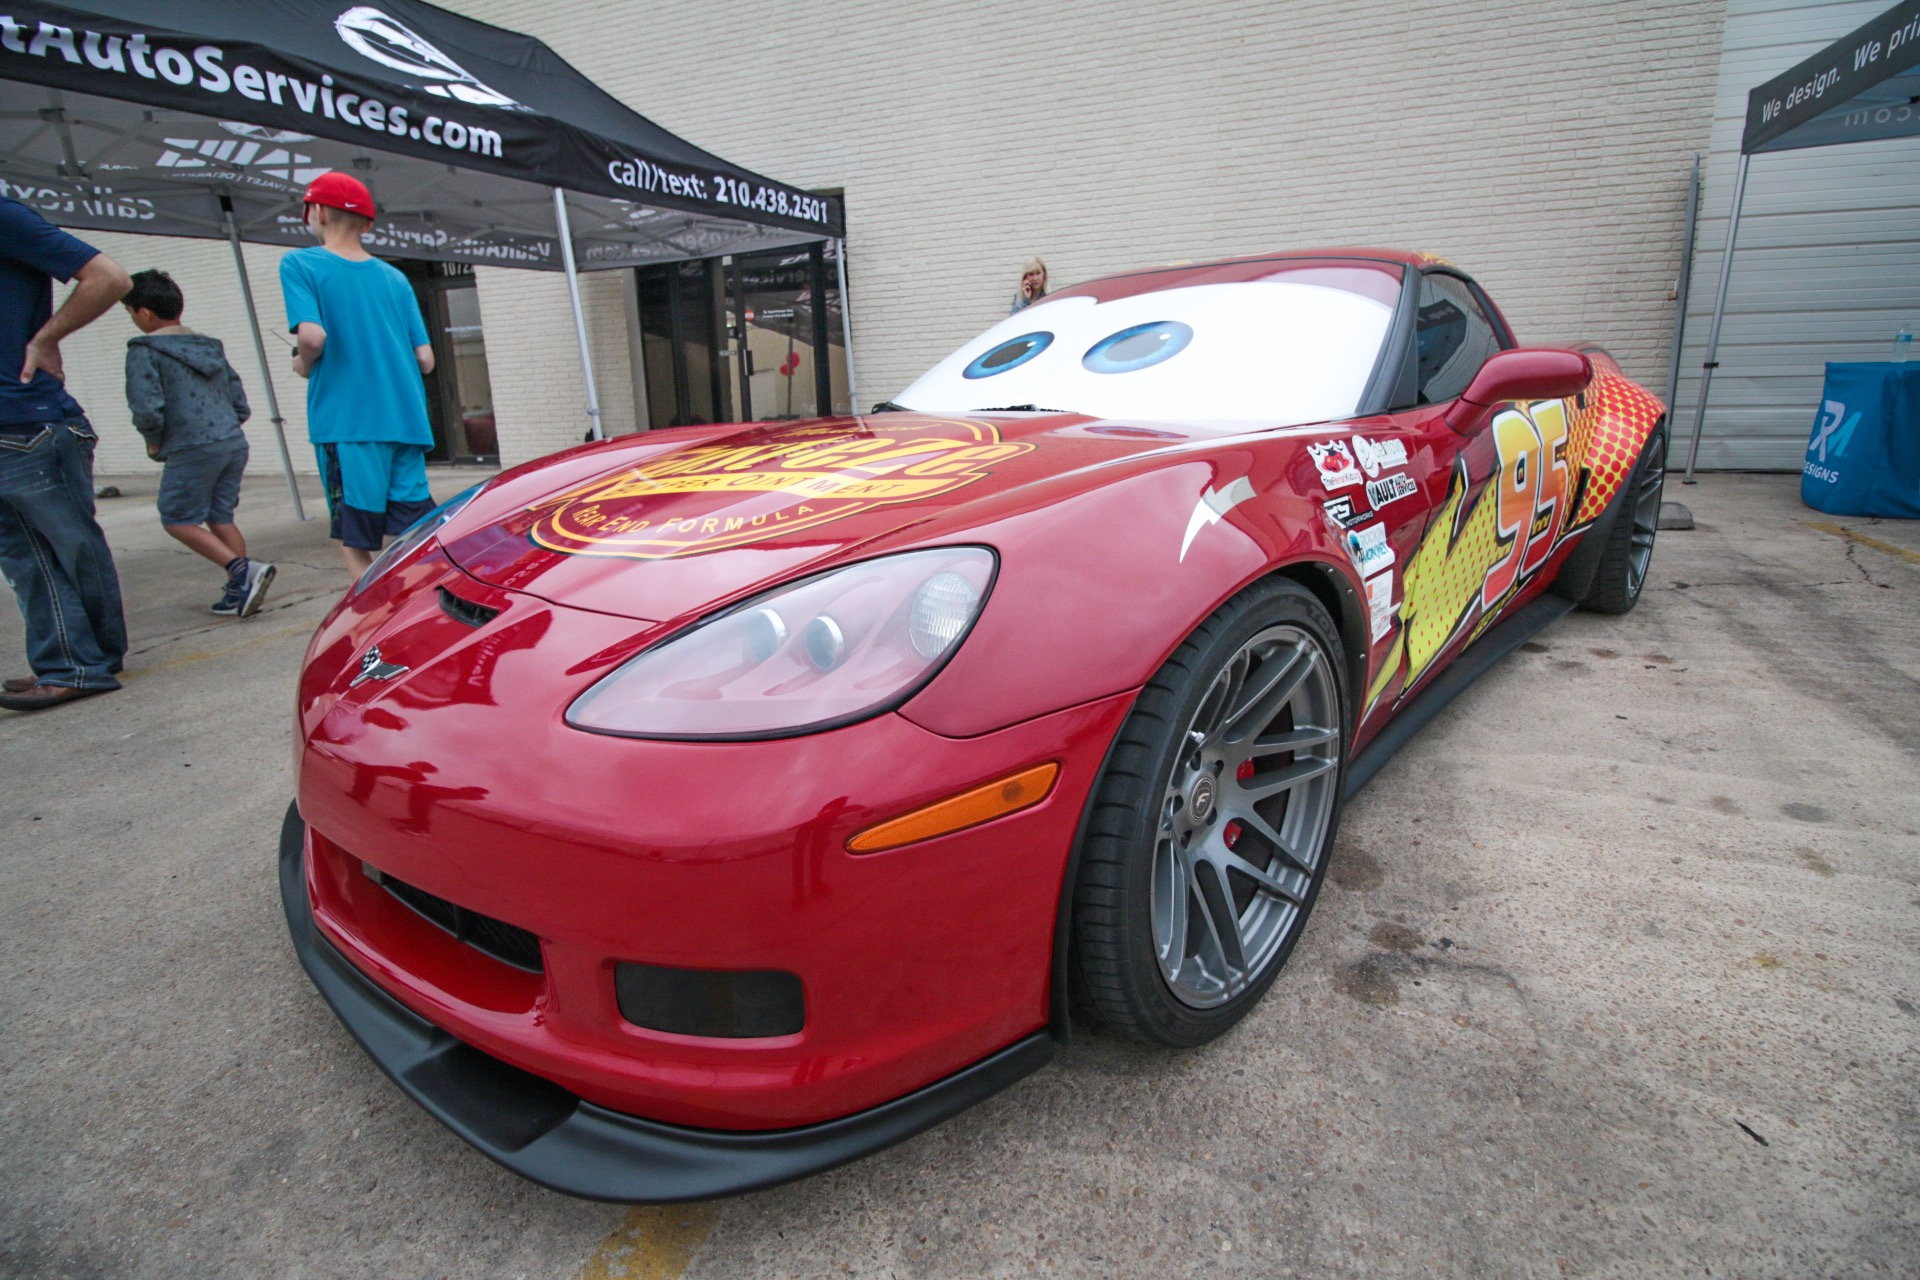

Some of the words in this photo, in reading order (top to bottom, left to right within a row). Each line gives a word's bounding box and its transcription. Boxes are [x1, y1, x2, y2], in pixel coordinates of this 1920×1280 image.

[1762, 99, 1781, 123] We
[1786, 67, 1841, 109] design.
[1854, 41, 1881, 71] We
[1887, 14, 1920, 59] pri
[608, 158, 707, 200] call/text:
[714, 176, 829, 224] 210.438.2501
[727, 474, 908, 494] OINTMENT
[1368, 478, 1396, 507] VAULT
[1482, 398, 1568, 613] 95
[572, 504, 608, 528] REAR
[597, 516, 650, 533] END
[656, 504, 815, 534] FORMULA
